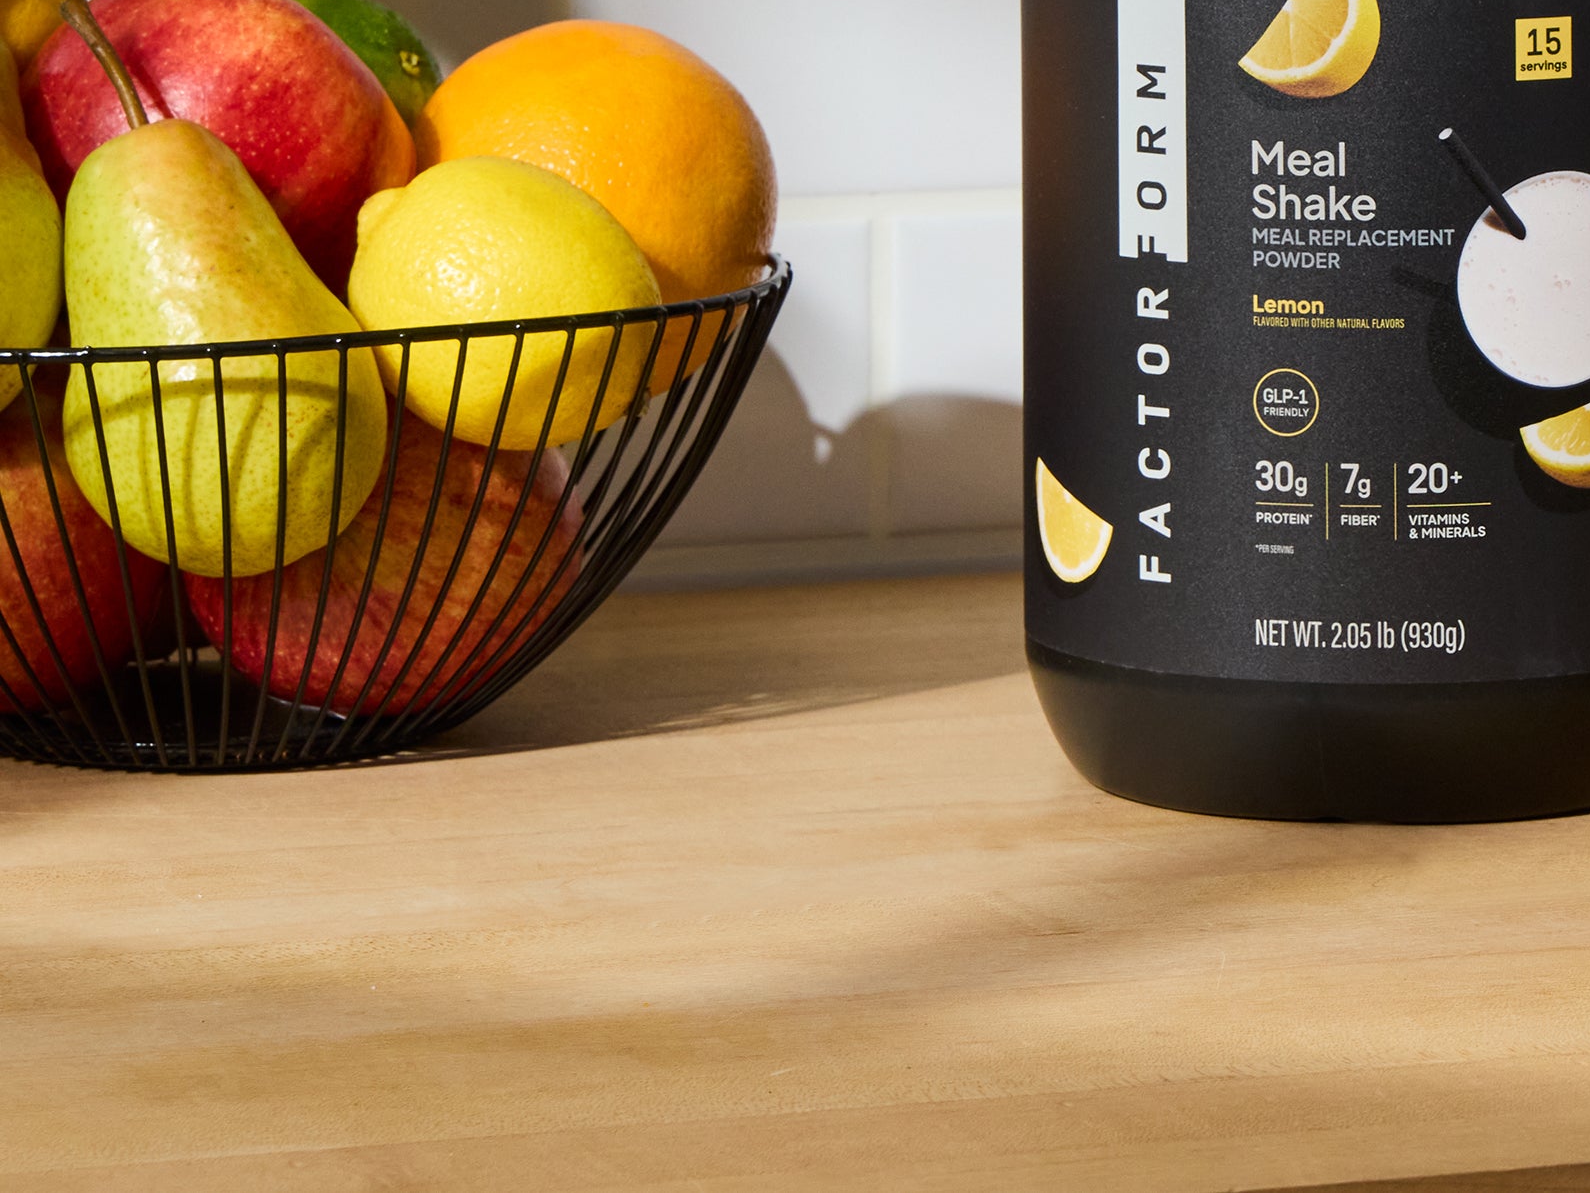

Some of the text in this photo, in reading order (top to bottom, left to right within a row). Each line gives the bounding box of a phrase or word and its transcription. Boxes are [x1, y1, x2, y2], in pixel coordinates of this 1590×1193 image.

[1527, 27, 1562, 56] 15
[1520, 60, 1567, 73] servings
[1251, 139, 1346, 177] Meal
[1251, 183, 1377, 221] Shake
[1252, 227, 1456, 247] MEAL REPLACEMENT
[1252, 250, 1341, 269] POWDER
[1252, 294, 1325, 315] Lemon
[1252, 316, 1406, 329] FLAVORED WITH OTHER NATURAL FLAVORS
[1262, 387, 1309, 405] GLP-1
[1263, 406, 1310, 417] FRIENDLY
[1255, 460, 1308, 497] 30g
[1340, 463, 1371, 499] 7g
[1407, 462, 1463, 494] 20+
[1408, 513, 1470, 526] VITAMINS
[1408, 525, 1487, 539] & MINERALS
[1255, 619, 1466, 654] NET WT. 2.05 lb (930g)
